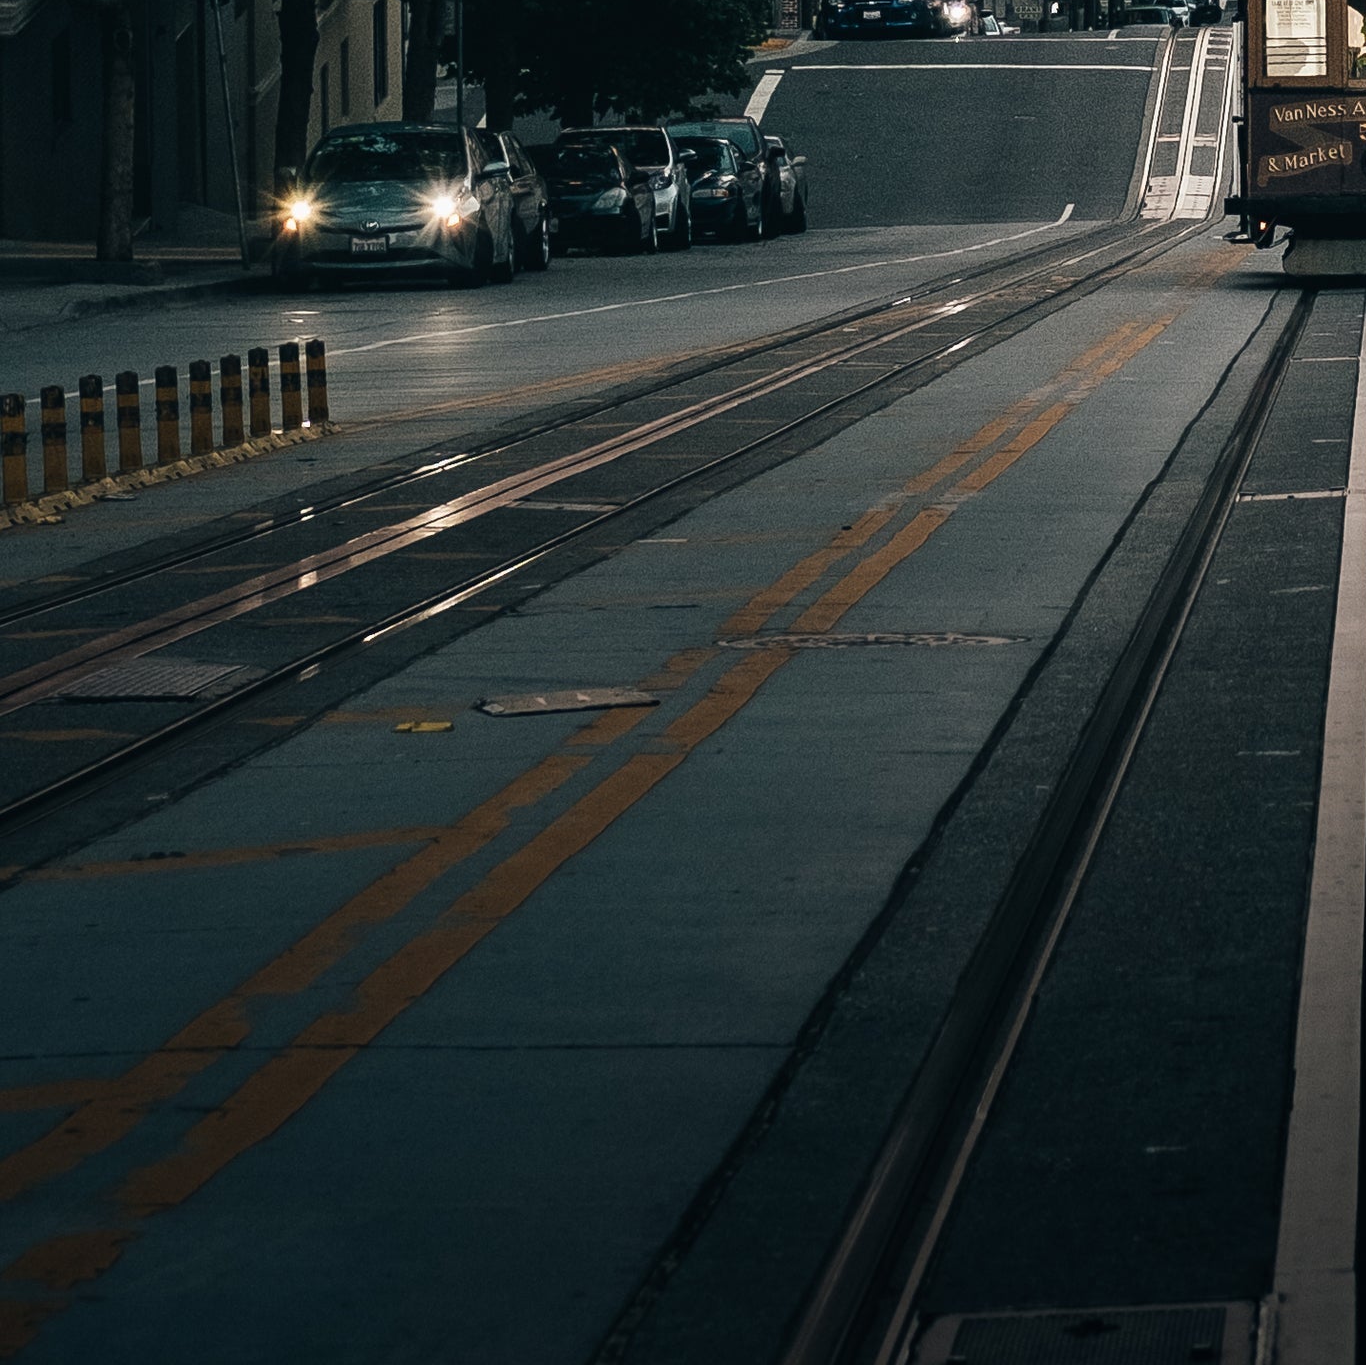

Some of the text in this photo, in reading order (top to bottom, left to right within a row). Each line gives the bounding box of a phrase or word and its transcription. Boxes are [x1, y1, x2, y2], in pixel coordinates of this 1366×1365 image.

[1274, 107, 1303, 122] Van
[1306, 103, 1347, 118] Ness
[1268, 144, 1346, 172] & Market
